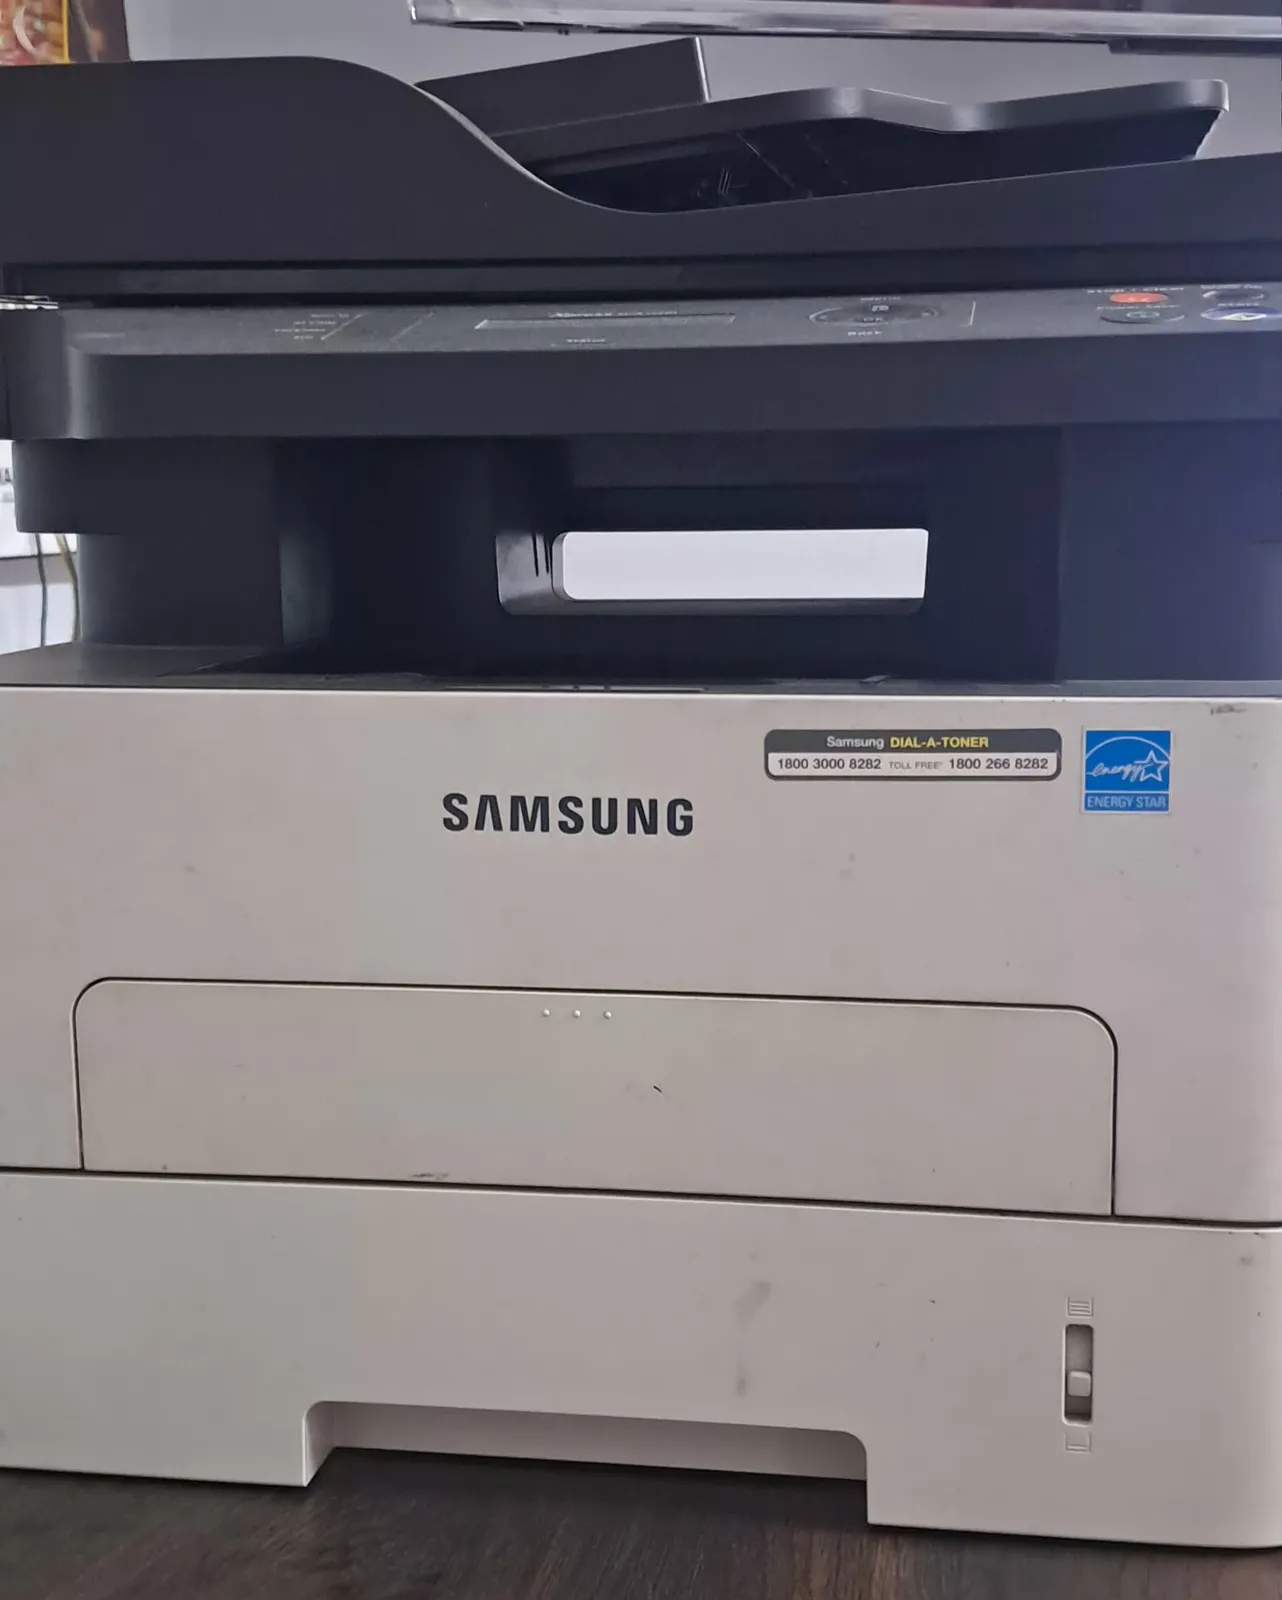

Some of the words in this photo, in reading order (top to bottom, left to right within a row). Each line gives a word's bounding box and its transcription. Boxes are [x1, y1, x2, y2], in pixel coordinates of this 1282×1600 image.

[826, 735, 885, 750] Samsung
[890, 736, 989, 748] DIAL-A-TONER
[778, 758, 809, 770] 1800
[812, 758, 845, 770] 3000
[849, 758, 881, 770] 8282
[889, 760, 912, 770] TOLL
[949, 758, 981, 770] 1800
[985, 758, 1010, 770] 266
[1014, 758, 1049, 770] 8282
[1087, 795, 1134, 808] ENERGY
[1136, 795, 1166, 808] STAR
[442, 792, 694, 837] SAMSUNG
